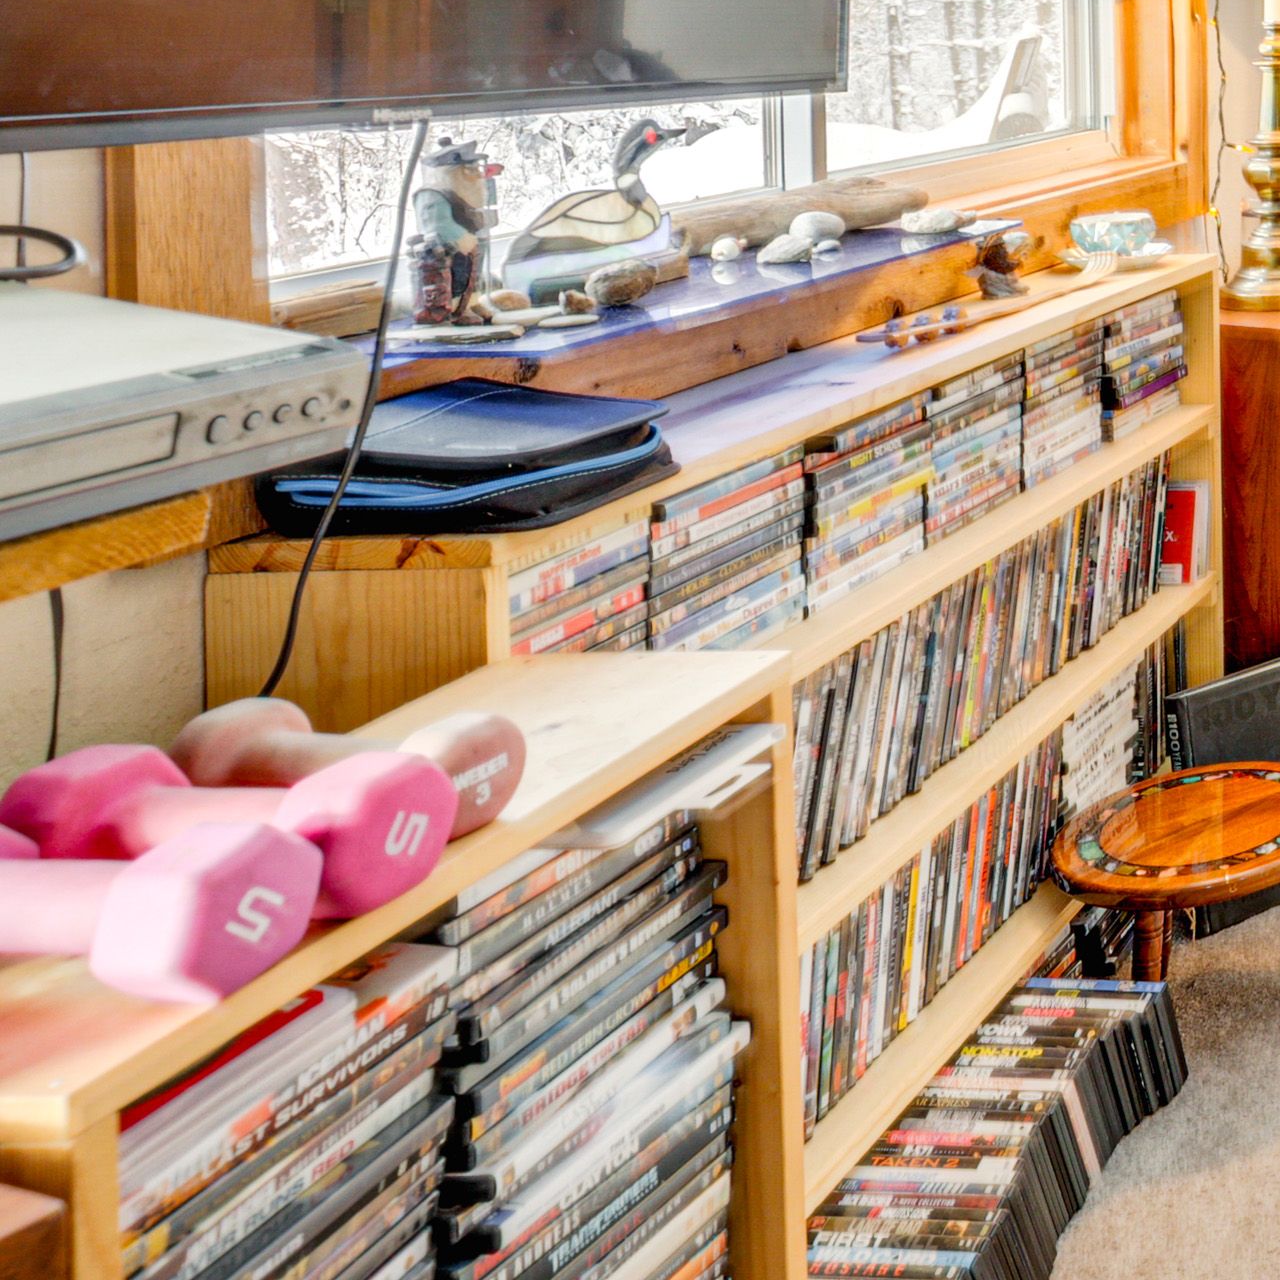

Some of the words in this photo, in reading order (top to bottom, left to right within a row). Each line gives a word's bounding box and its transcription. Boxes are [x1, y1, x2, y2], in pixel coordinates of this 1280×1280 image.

[849, 445, 876, 470] NIGHT
[475, 780, 491, 807] 3
[384, 809, 431, 858] 5
[225, 885, 285, 945] 5
[539, 884, 621, 951] ALLEGIANT
[1022, 1007, 1077, 1018] RAMBO
[294, 1012, 389, 1093] ICEMAN
[567, 1020, 608, 1059] FERN
[960, 1045, 1044, 1059] NON-STOP
[517, 1062, 590, 1126] BRIDGE
[615, 1014, 649, 1049] FAR
[198, 1118, 273, 1180] LAST
[269, 1022, 409, 1130] SURVIVORS
[931, 1097, 972, 1108] EXPRESS
[308, 1138, 355, 1182] RED
[870, 1156, 940, 1169] TAKEN
[942, 1158, 962, 1169] 2
[546, 1165, 662, 1272] TRANSFORMERS
[917, 1197, 957, 1208] COLLECTION
[510, 1209, 580, 1276] ANDREAS
[812, 1230, 890, 1249] FIRST
[886, 1233, 940, 1250] KILL
[809, 1263, 908, 1278] HOSTAGE
